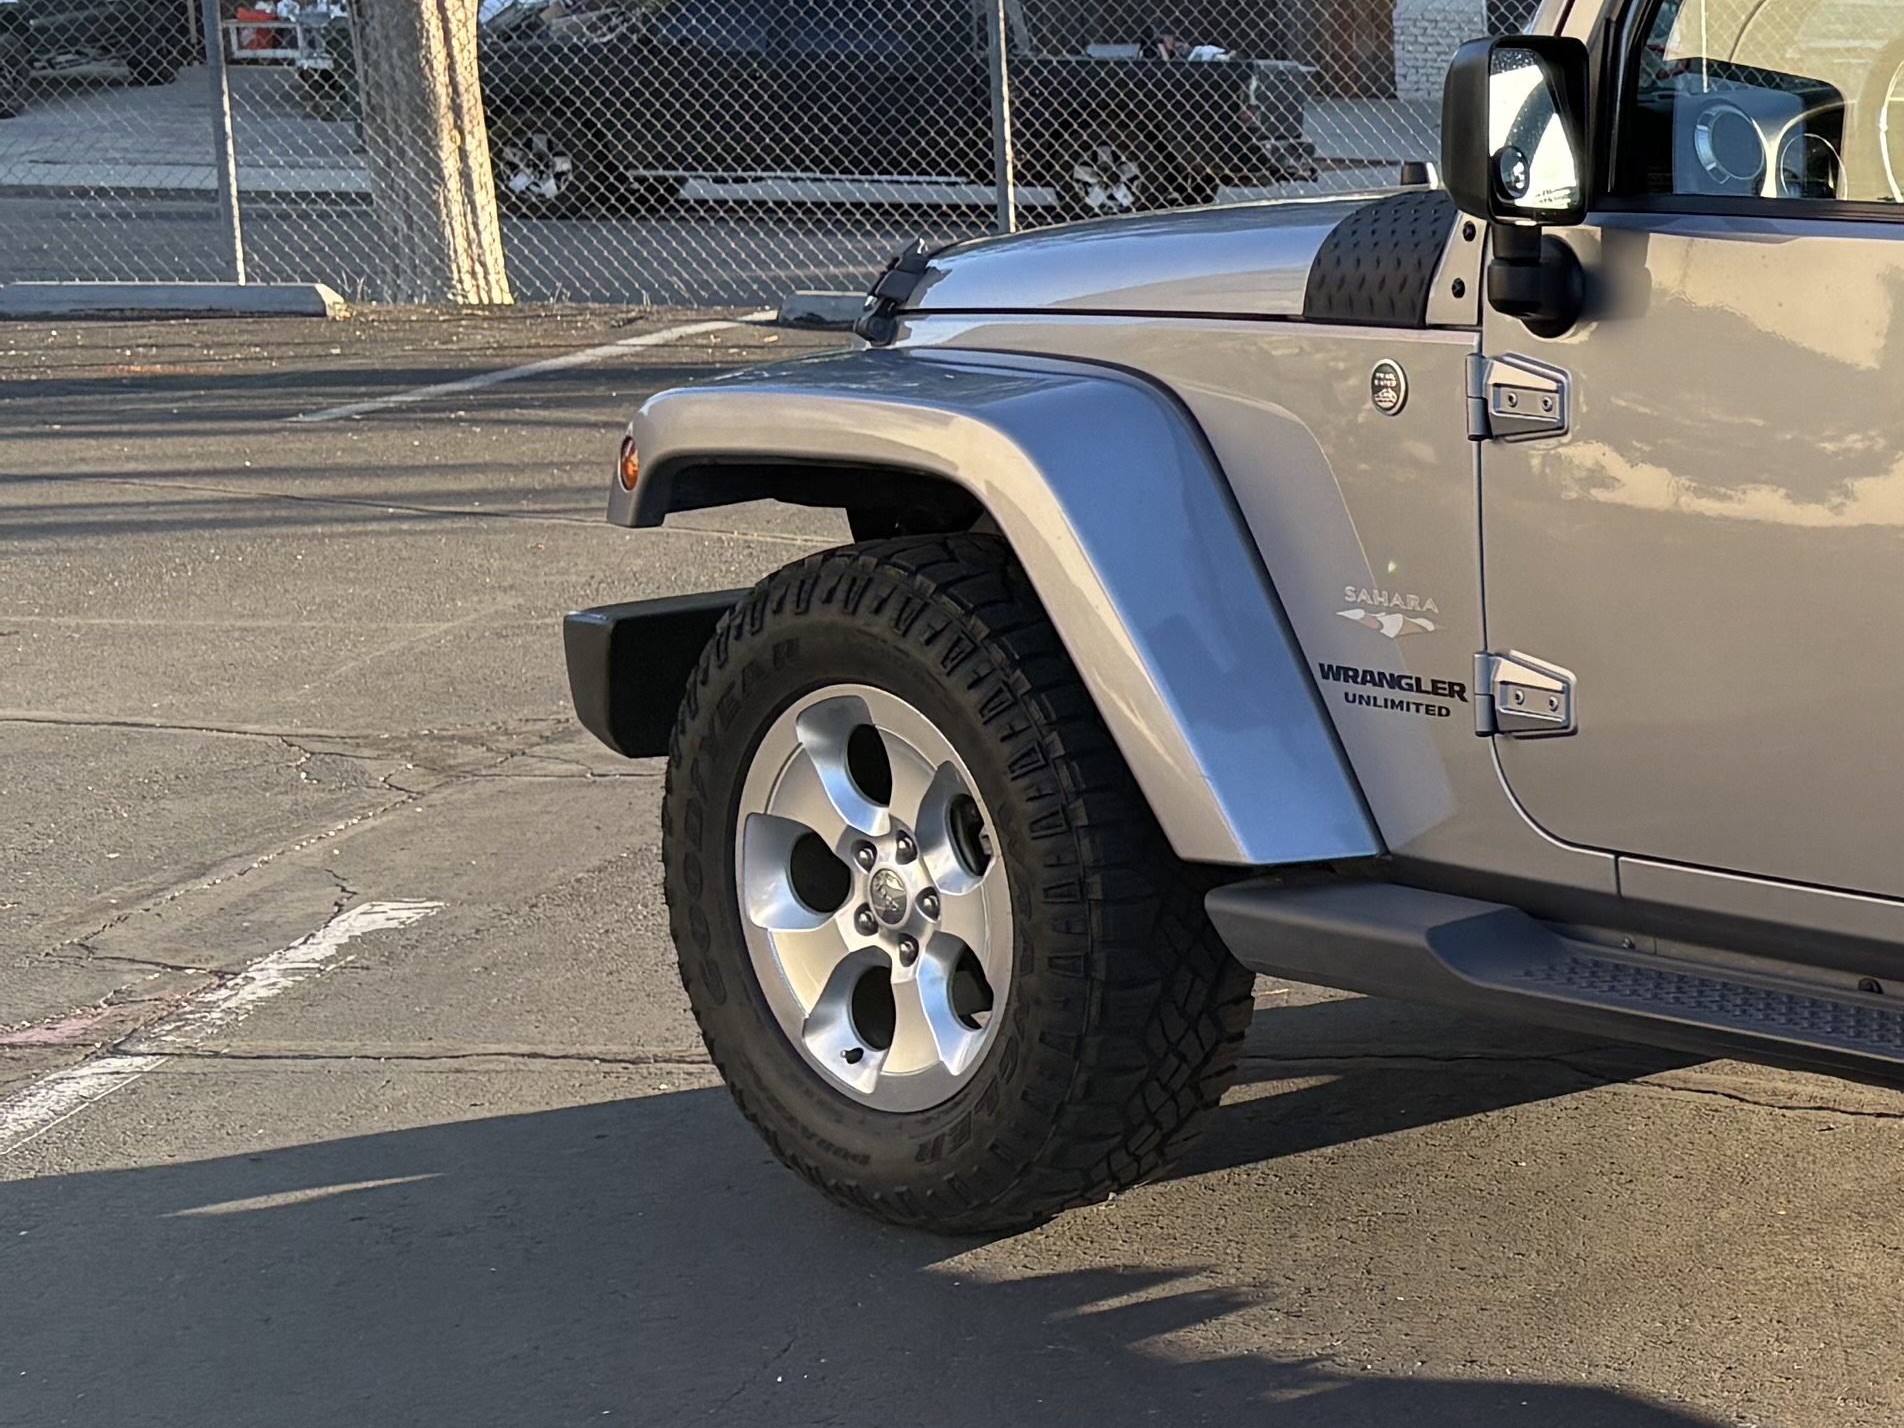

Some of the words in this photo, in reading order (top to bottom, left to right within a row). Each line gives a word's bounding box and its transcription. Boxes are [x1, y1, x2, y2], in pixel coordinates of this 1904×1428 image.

[1344, 585, 1439, 614] SAHARA
[1318, 662, 1469, 703] WRANGLER
[1344, 690, 1451, 718] UNLIMITED
